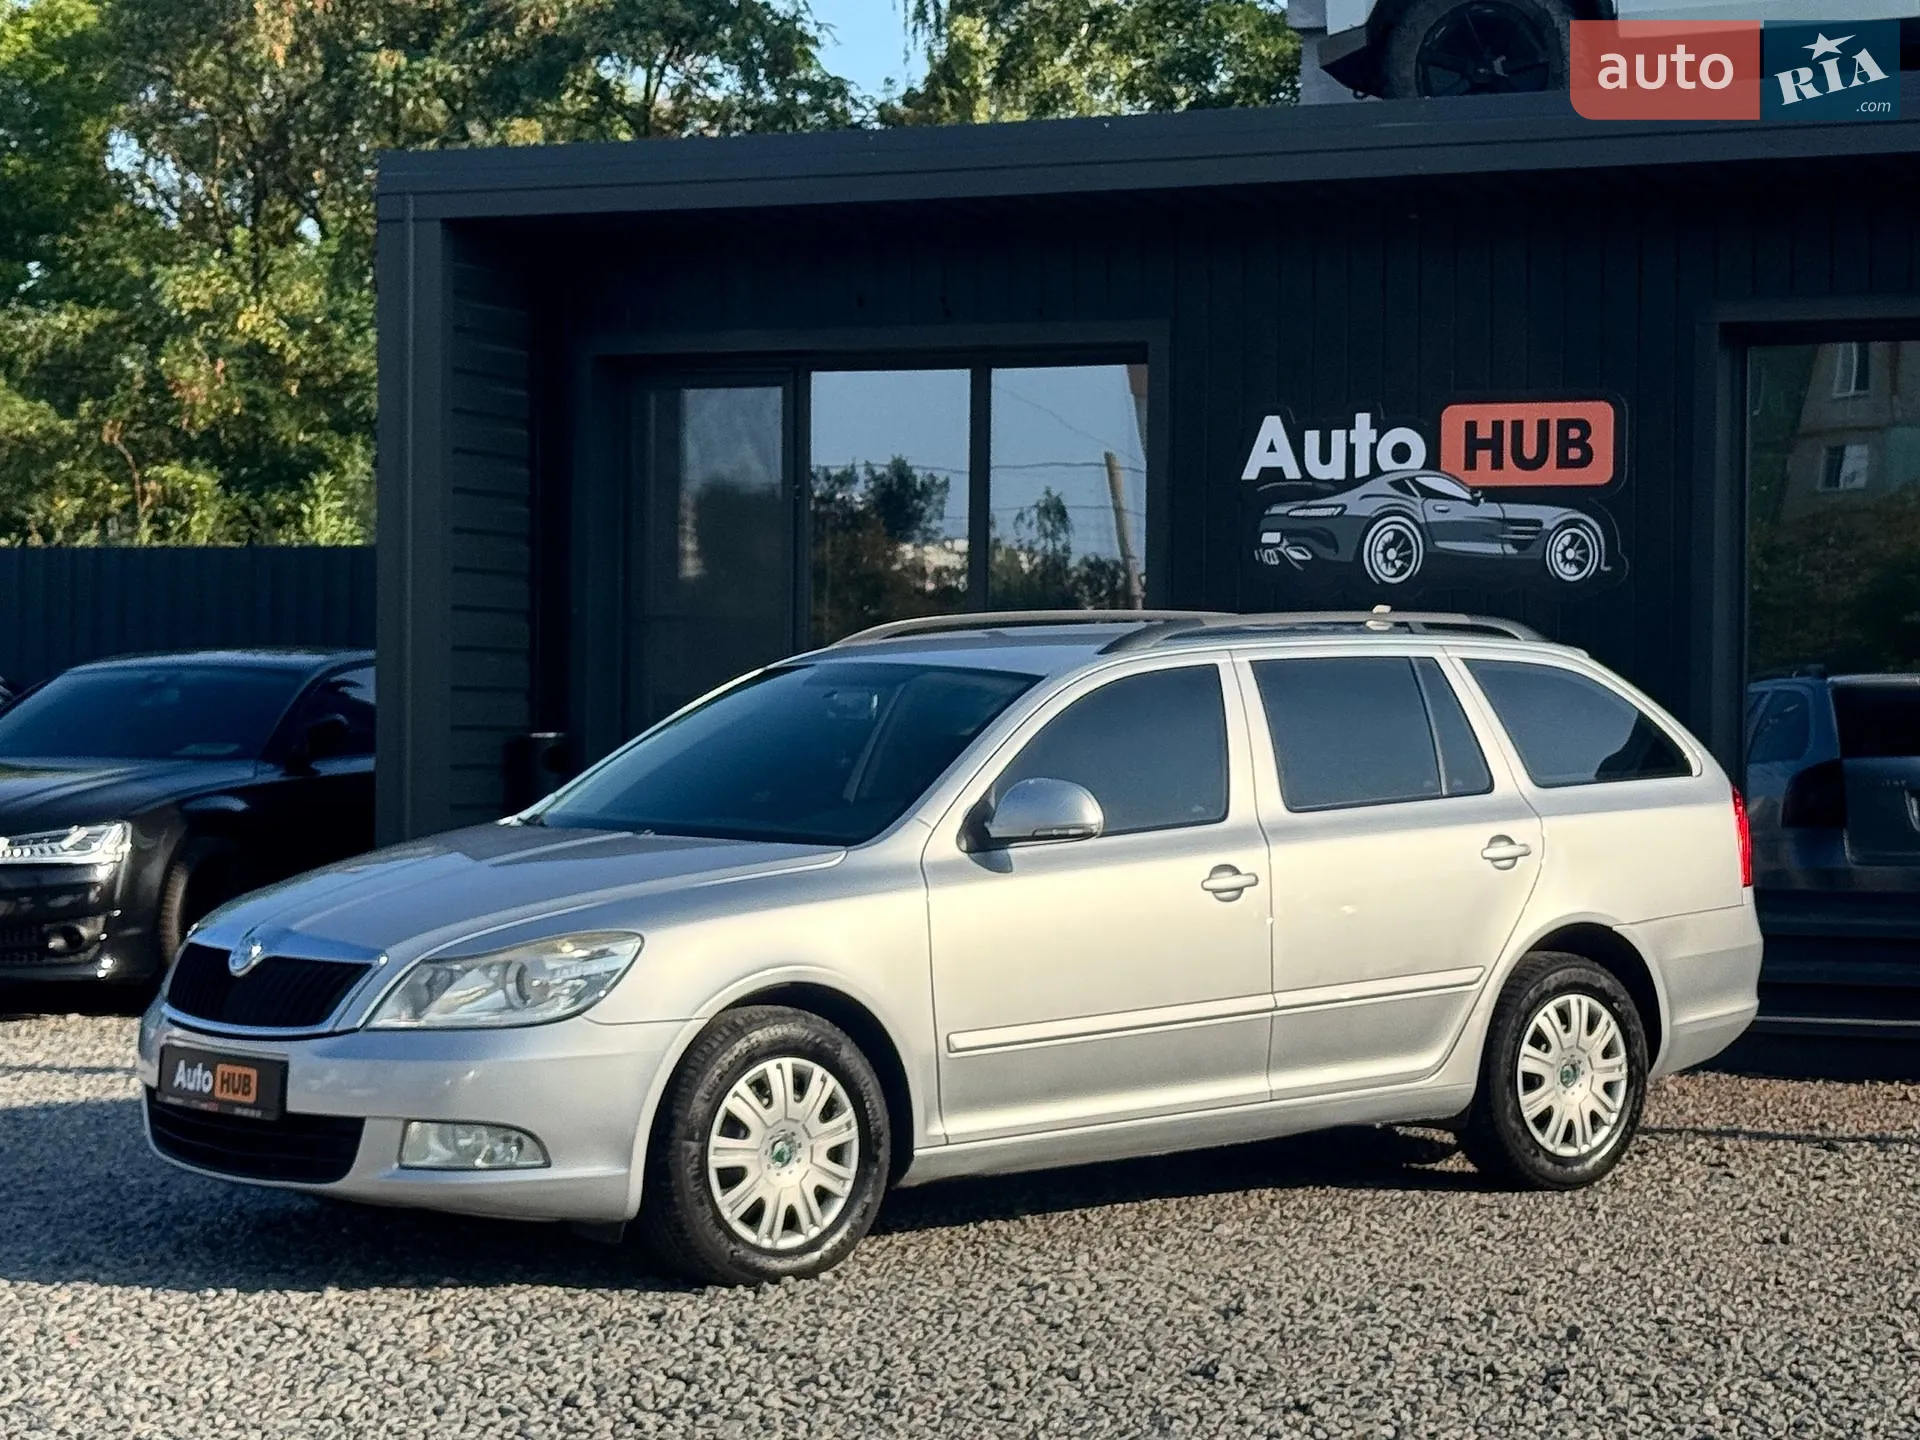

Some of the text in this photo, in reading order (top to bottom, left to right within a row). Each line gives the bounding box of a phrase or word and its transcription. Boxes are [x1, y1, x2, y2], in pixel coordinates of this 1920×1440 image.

[1241, 412, 1595, 481] Auto HUB
[172, 1059, 252, 1097] Auto HUB
